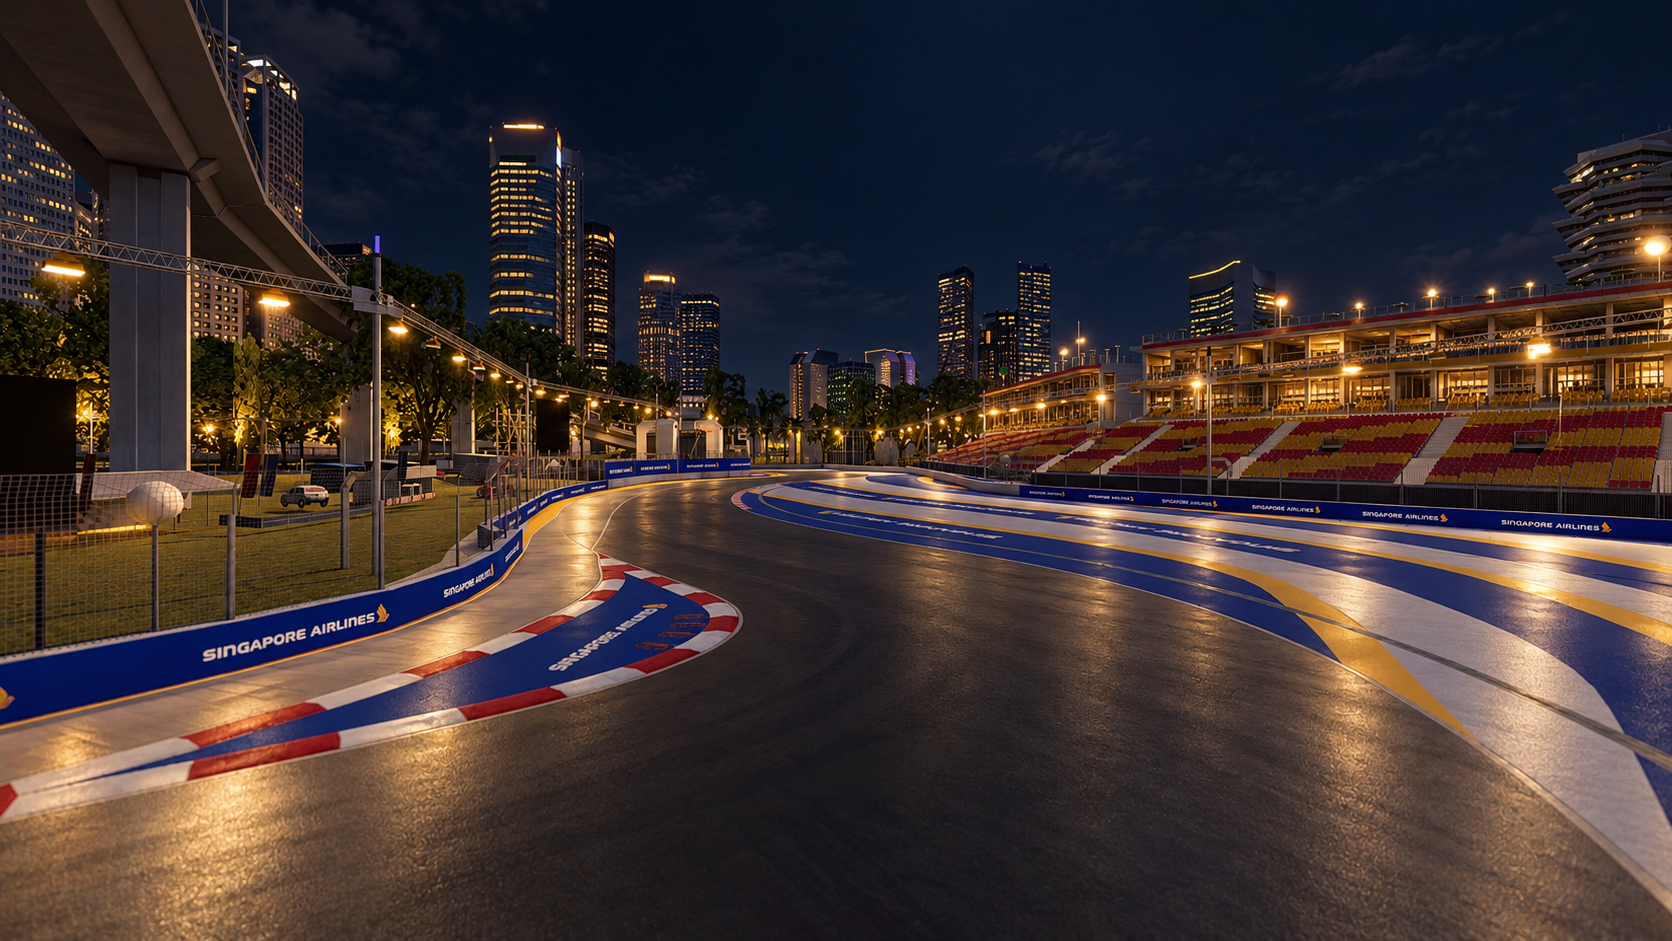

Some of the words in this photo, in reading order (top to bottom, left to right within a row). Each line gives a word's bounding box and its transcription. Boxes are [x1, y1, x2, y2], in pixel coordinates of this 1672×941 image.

[1362, 511, 1403, 519] SINGAPORE
[1501, 519, 1553, 529] SINGAPORE
[1555, 522, 1600, 532] AIRLINES
[202, 628, 307, 663] SINGAPORE
[310, 612, 376, 638] AIRLINES
